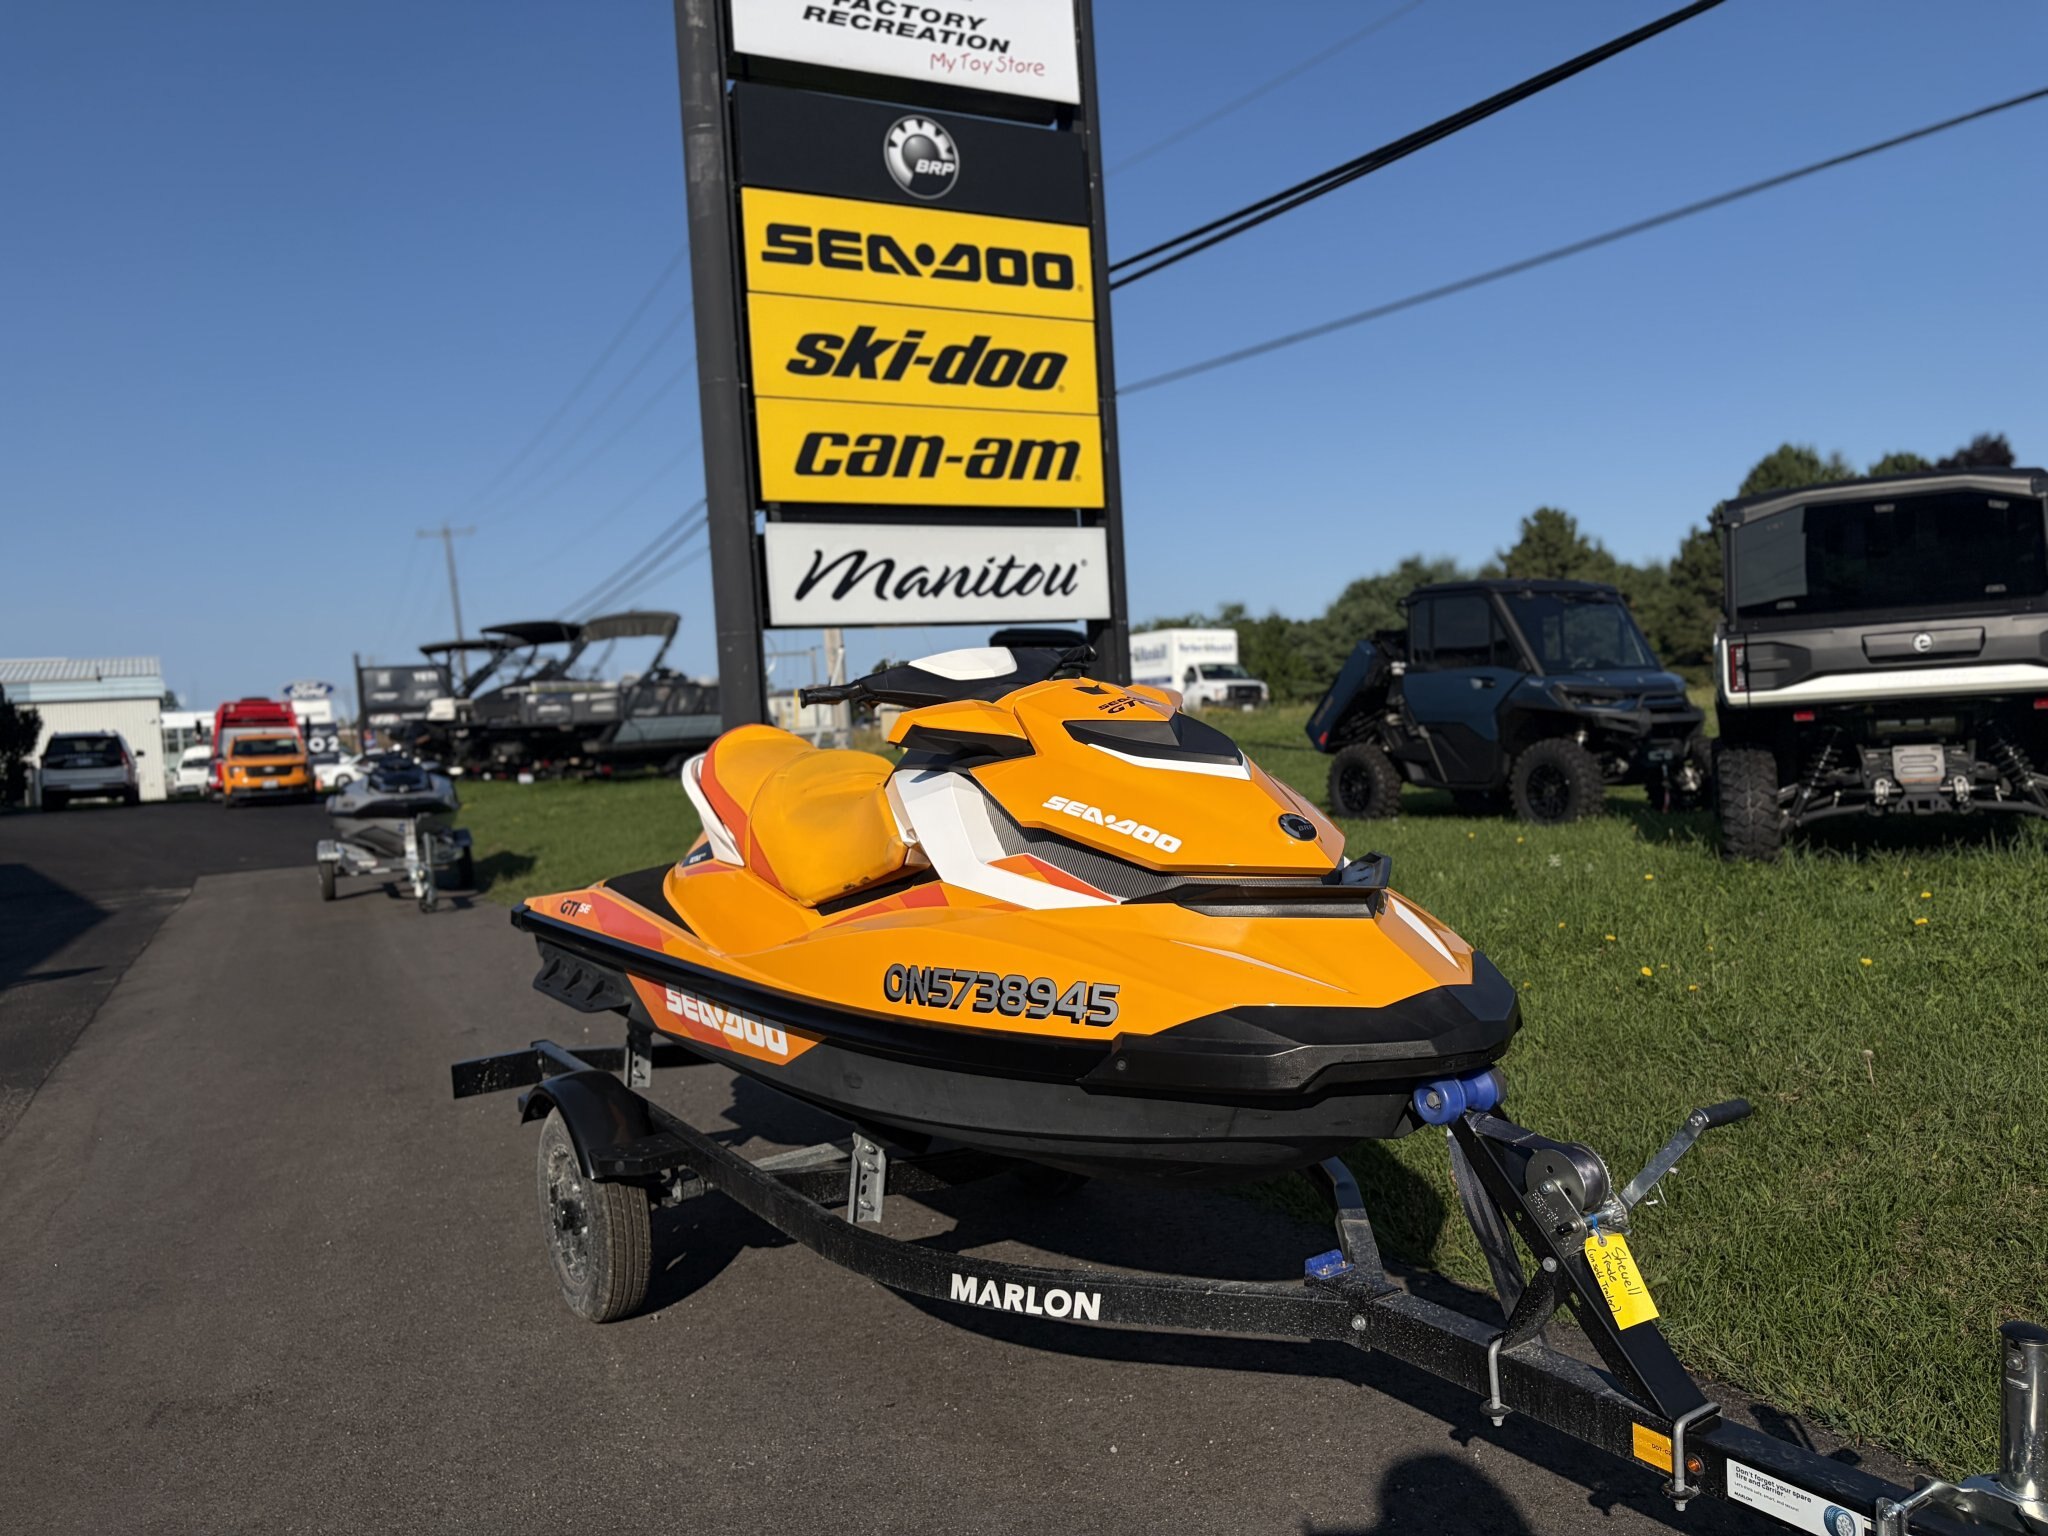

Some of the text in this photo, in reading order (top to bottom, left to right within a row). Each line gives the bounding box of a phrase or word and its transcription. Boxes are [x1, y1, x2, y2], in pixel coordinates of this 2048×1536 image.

[802, 5, 1011, 54] RECREATION
[915, 159, 956, 177] BRP
[786, 325, 1069, 392] ski-doo
[794, 431, 1081, 481] can-am
[795, 549, 1079, 602] Manitou
[883, 963, 1121, 1028] ON5738945
[950, 1273, 1102, 1321] MARLON
[1734, 1491, 1753, 1502] MARLON
[1735, 1472, 1748, 1482] tire
[1748, 1477, 1761, 1487] and
[1735, 1466, 1812, 1503] Don't forget your spare
